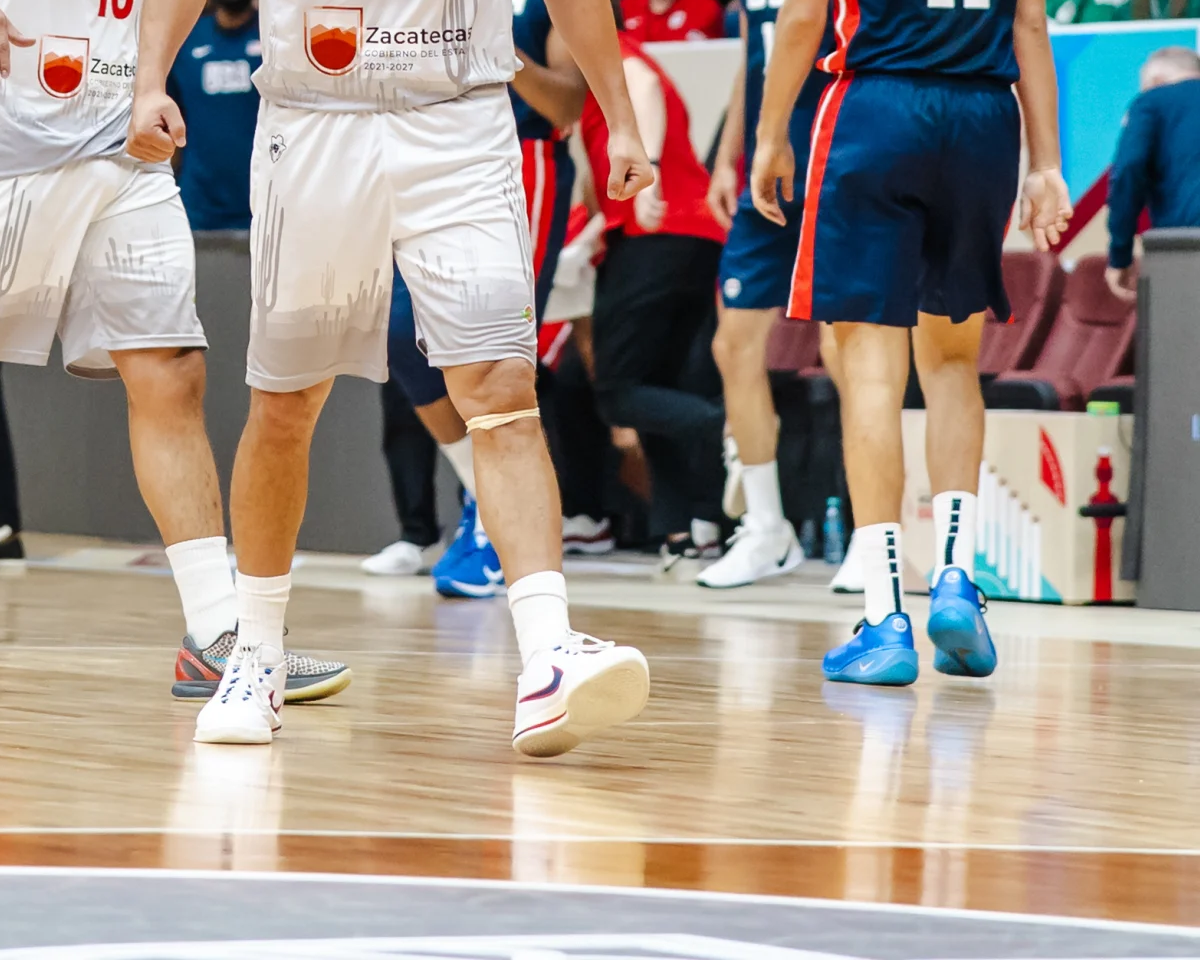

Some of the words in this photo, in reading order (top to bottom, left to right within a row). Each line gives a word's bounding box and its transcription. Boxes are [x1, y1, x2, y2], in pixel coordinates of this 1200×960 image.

[364, 50, 417, 58] GOBIERNO
[420, 49, 438, 58] DEL
[364, 62, 414, 71] 2021-2027
